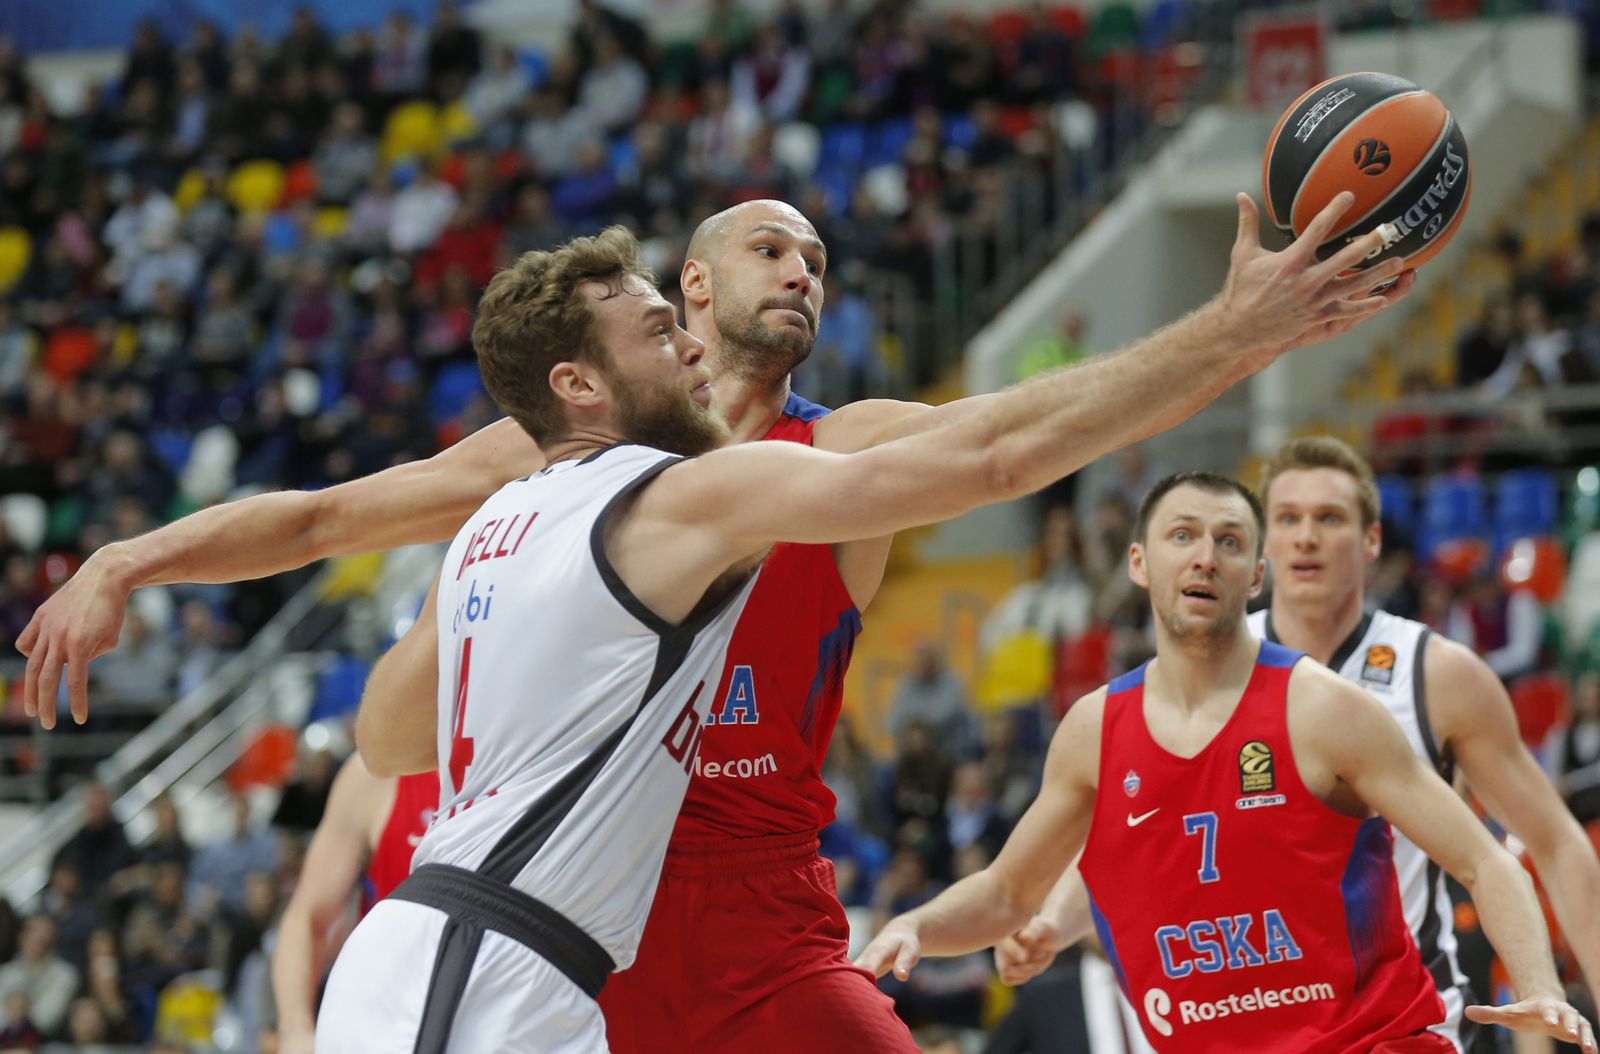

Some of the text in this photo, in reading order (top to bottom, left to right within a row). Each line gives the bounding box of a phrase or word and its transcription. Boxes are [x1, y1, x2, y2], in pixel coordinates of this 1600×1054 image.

[1353, 142, 1464, 260] SPALDI
[456, 511, 540, 581] ELLI
[706, 665, 760, 726] A
[1182, 811, 1220, 883] 7
[1154, 909, 1304, 980] CSKA
[1178, 982, 1336, 1025] Rostelecom
